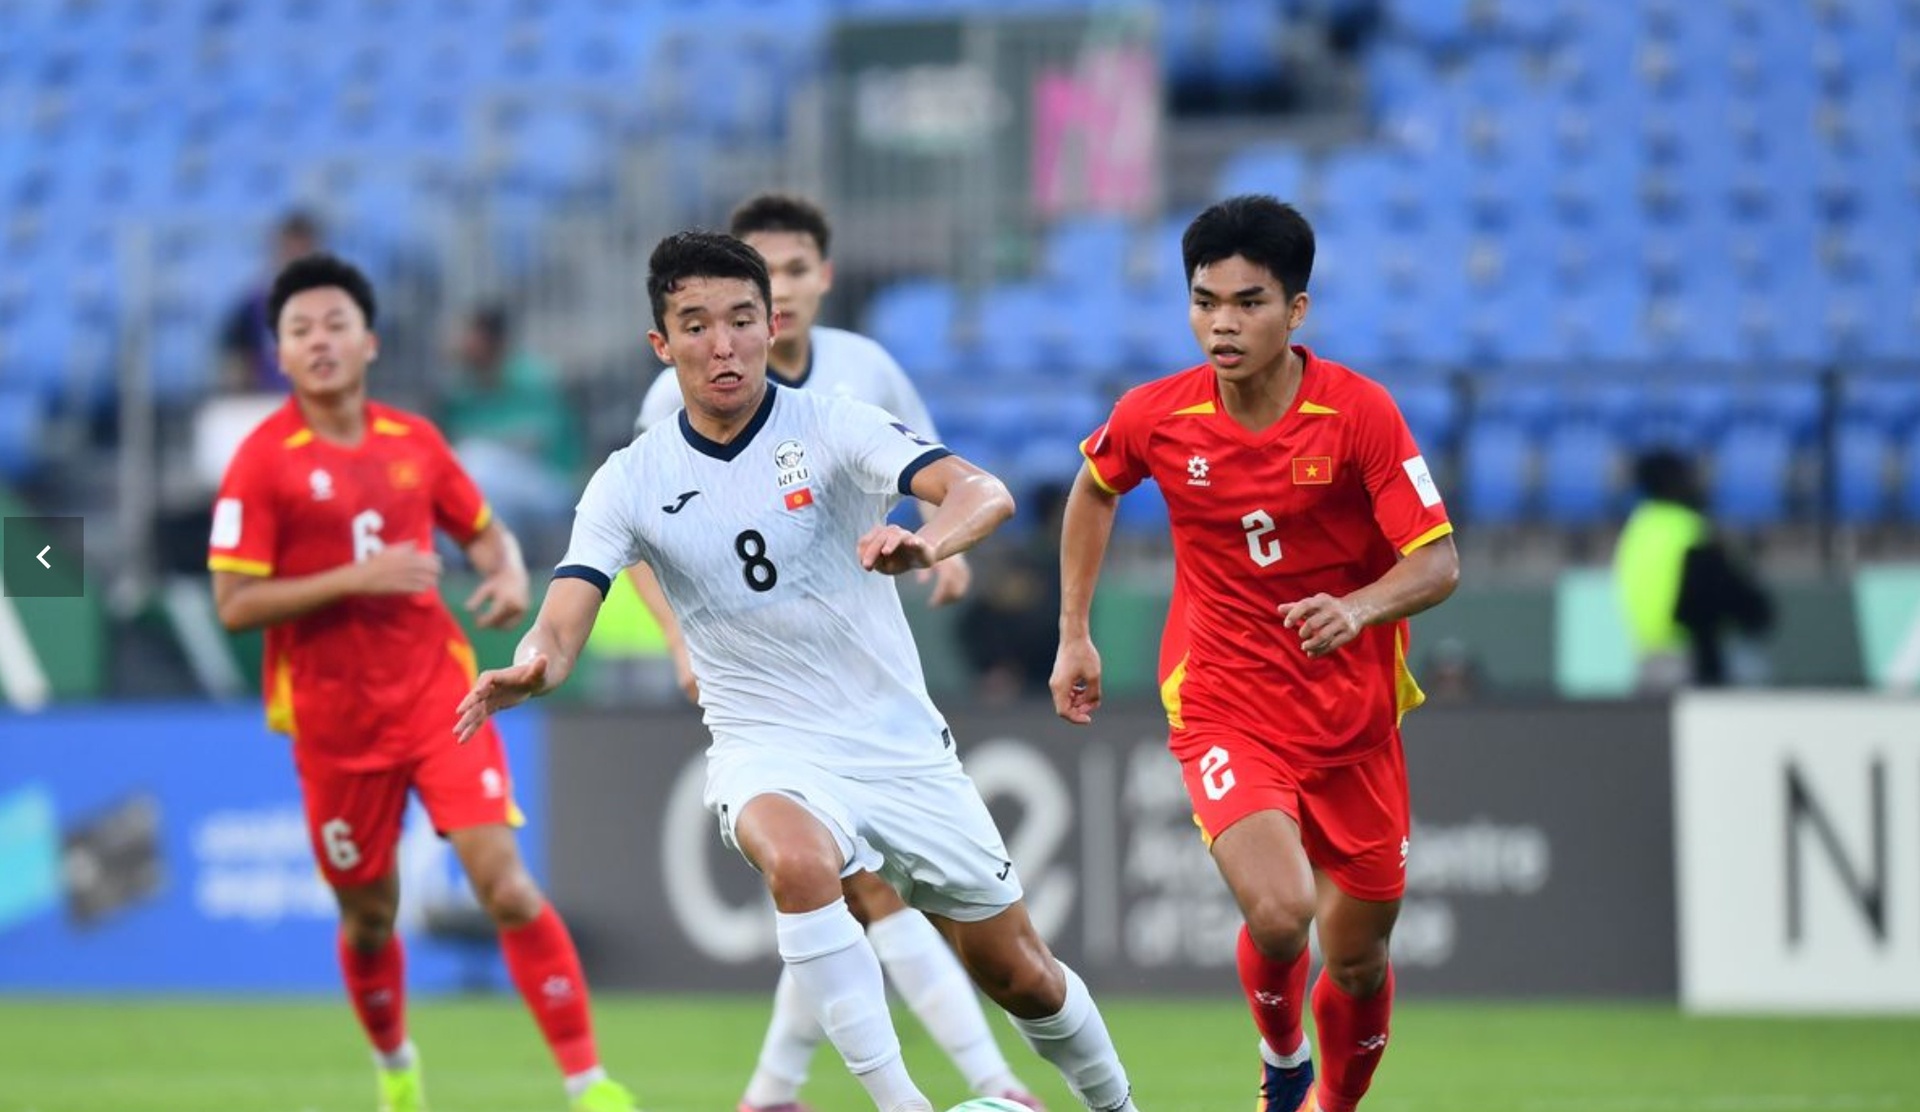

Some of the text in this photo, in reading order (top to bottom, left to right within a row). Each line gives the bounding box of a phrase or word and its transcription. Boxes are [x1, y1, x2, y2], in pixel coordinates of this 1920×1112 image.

[734, 529, 777, 593] 8
[1241, 508, 1282, 567] 2
[1199, 745, 1236, 800] 2
[322, 816, 362, 871] 6
[1783, 757, 1890, 947] N
